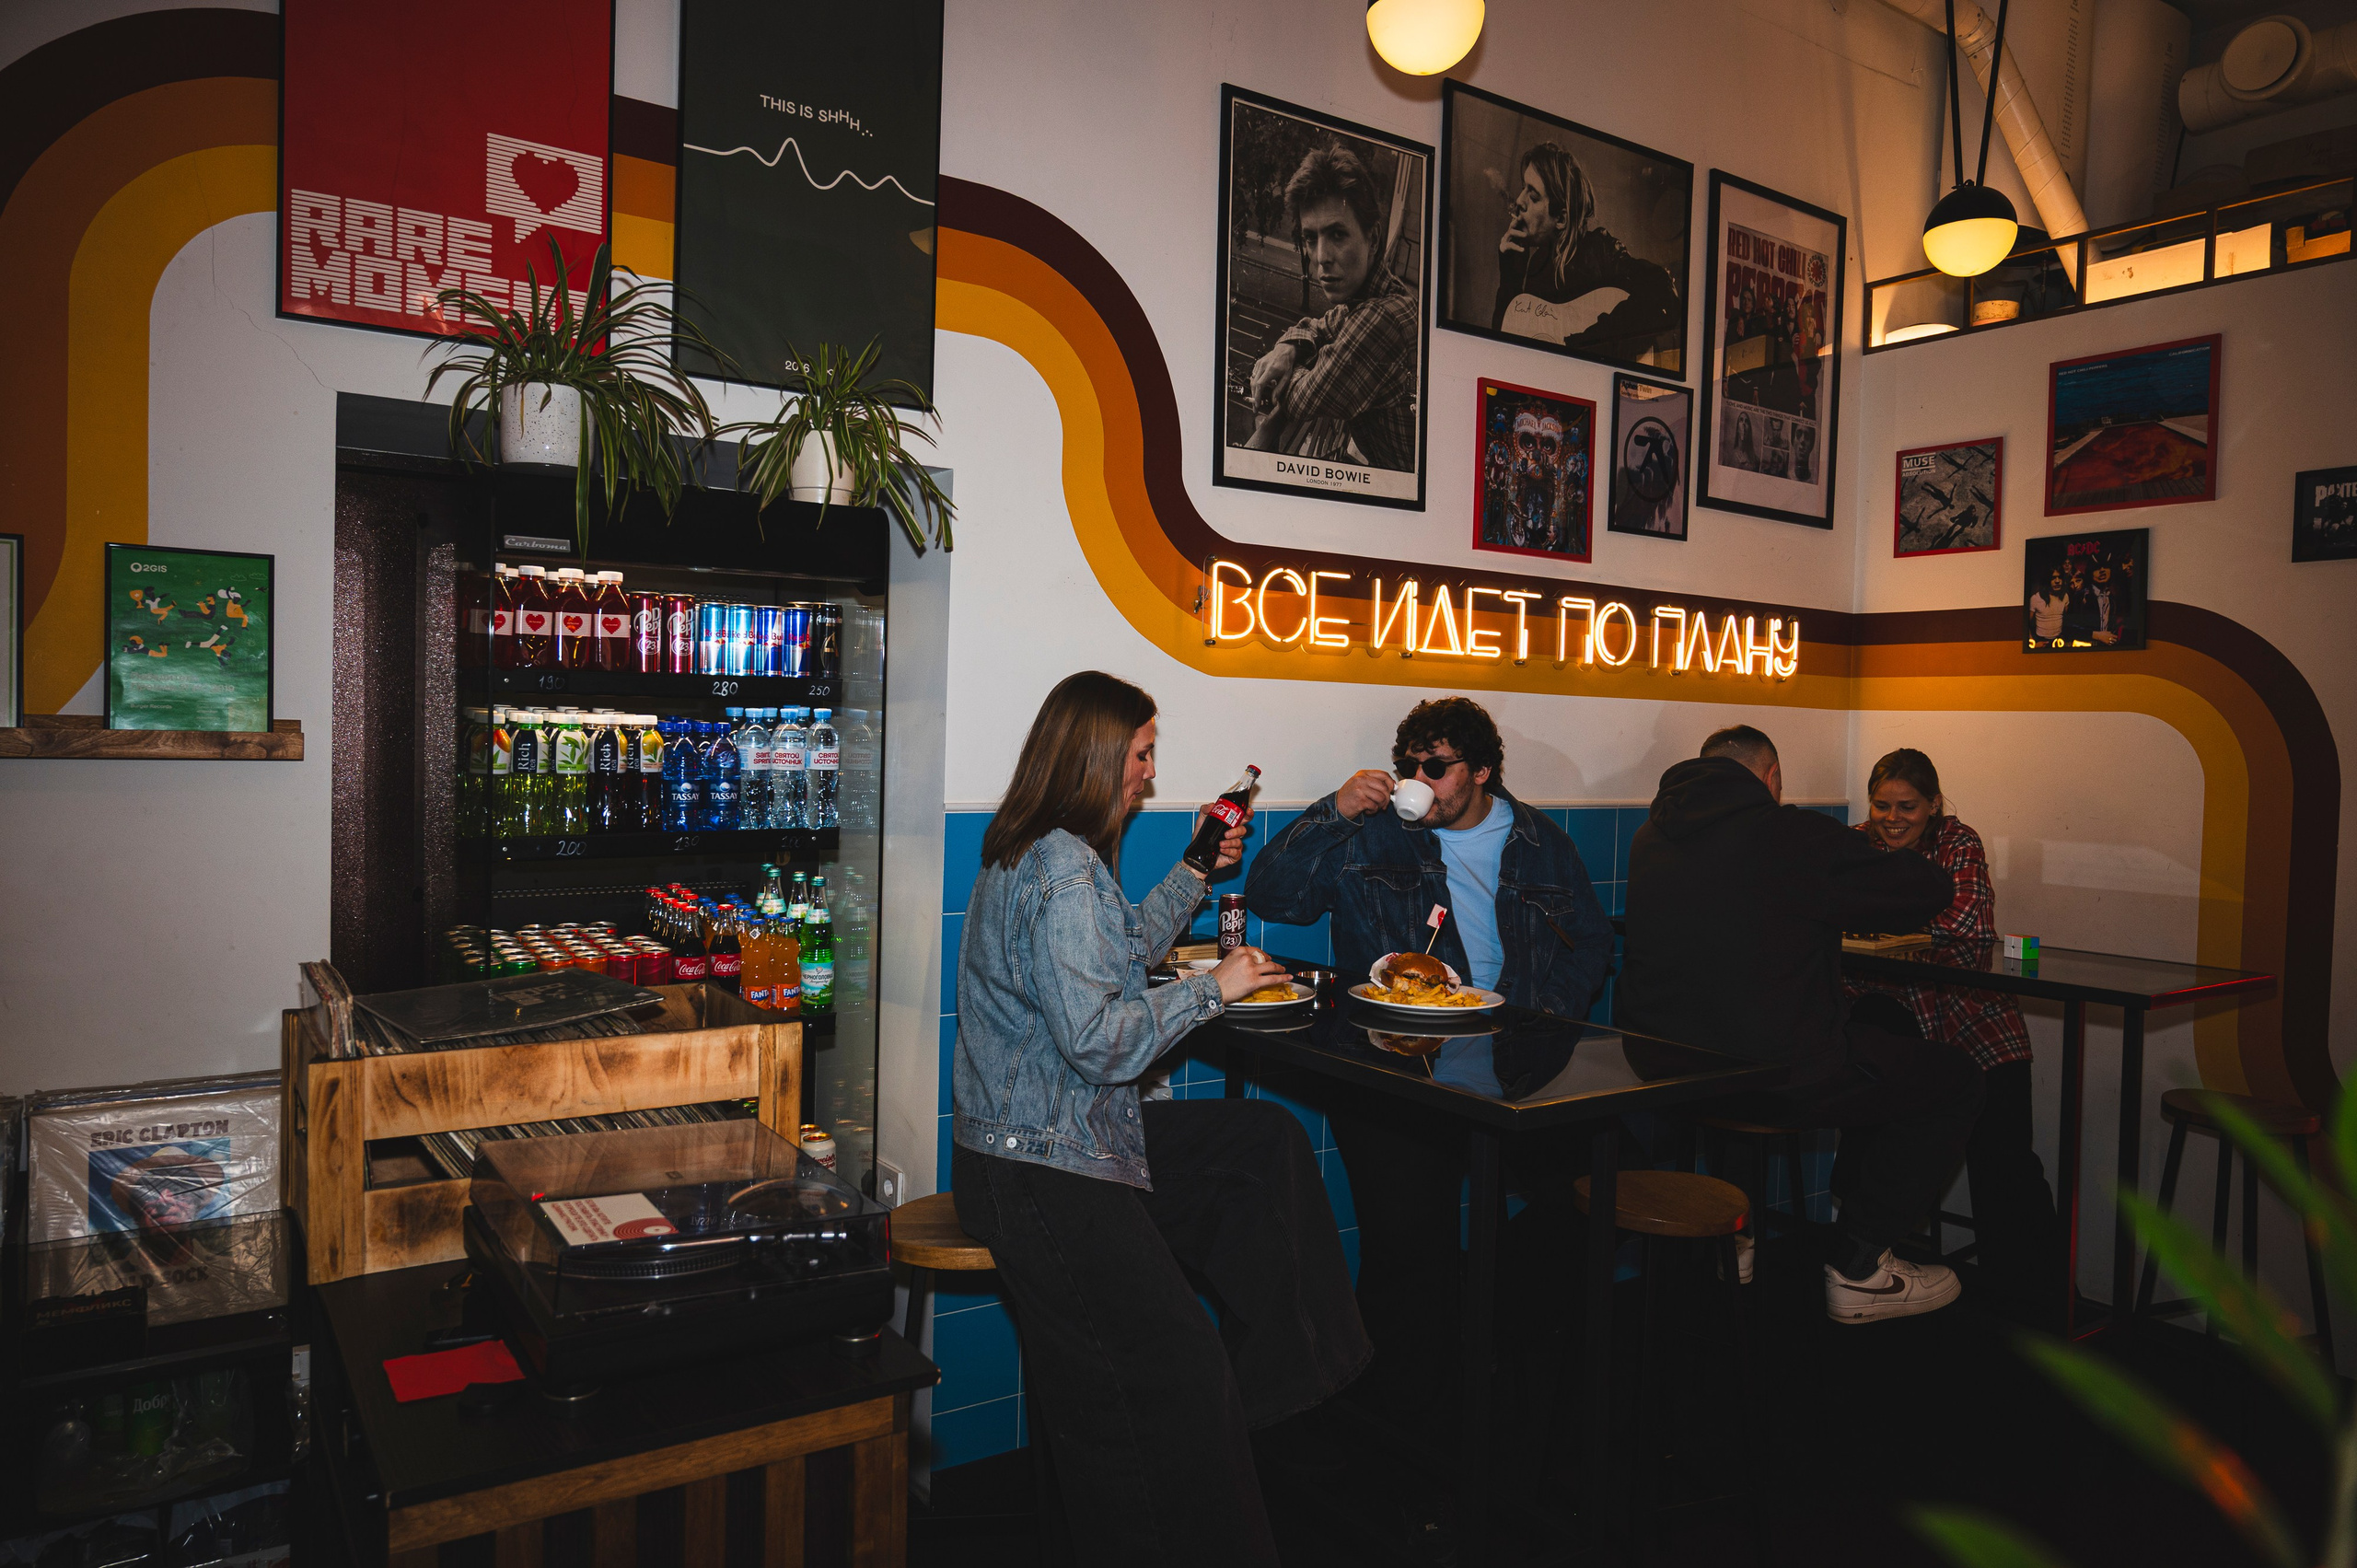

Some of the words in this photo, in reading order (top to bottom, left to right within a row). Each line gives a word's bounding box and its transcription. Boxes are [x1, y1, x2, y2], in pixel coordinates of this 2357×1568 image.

[760, 94, 796, 115] THIS
[798, 104, 814, 119] IS
[291, 189, 492, 273] RARE
[1727, 226, 1750, 261] RED
[1752, 236, 1776, 270] HOT
[1777, 244, 1806, 280] CHILI
[784, 360, 810, 373] 206
[1638, 384, 1652, 394] Twin
[1902, 455, 1935, 469] MUSE
[1276, 460, 1320, 477] DAVID
[1325, 468, 1371, 484] BOWIE
[1902, 468, 1936, 477] ABSOLUTION
[1306, 478, 1329, 486] LONDON
[505, 538, 568, 551] Carboma
[143, 563, 168, 573] 2GIS
[1211, 559, 1352, 647] ВСЕ
[1372, 573, 1543, 657] ИДЕТ
[1558, 594, 1636, 666] ПО
[1650, 604, 1802, 679] ПЛАНУ
[539, 675, 566, 691] 190
[713, 680, 738, 697] 280
[809, 685, 830, 696] 250
[517, 742, 531, 770] Rich
[599, 743, 611, 770] Rich
[671, 793, 700, 801] TASSAY
[710, 792, 737, 800] TASSAY
[556, 840, 587, 856] 200
[674, 835, 700, 851] 130
[1231, 908, 1245, 921] Dr
[1226, 936, 1236, 946] 23
[90, 1129, 134, 1148] ERIC
[139, 1119, 229, 1142] CLAPTON
[37, 1297, 134, 1320] МЕМФЛИКС
[133, 1391, 172, 1414] Добр
